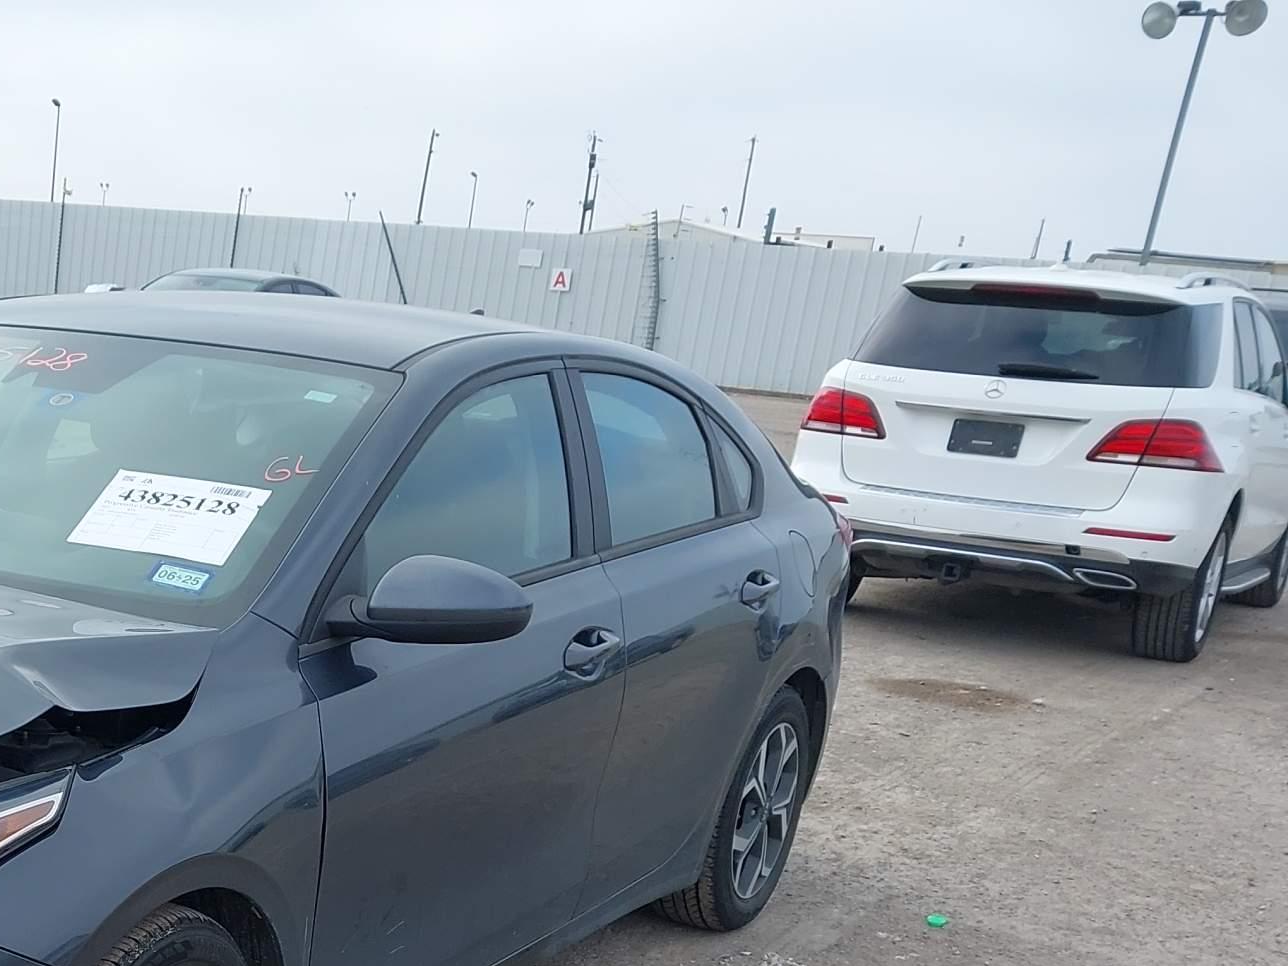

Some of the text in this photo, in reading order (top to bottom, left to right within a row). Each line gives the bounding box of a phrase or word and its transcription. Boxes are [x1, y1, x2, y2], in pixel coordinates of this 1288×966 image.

[553, 271, 567, 288] A
[118, 488, 241, 517] 43825128
[158, 569, 202, 586] 06 25
